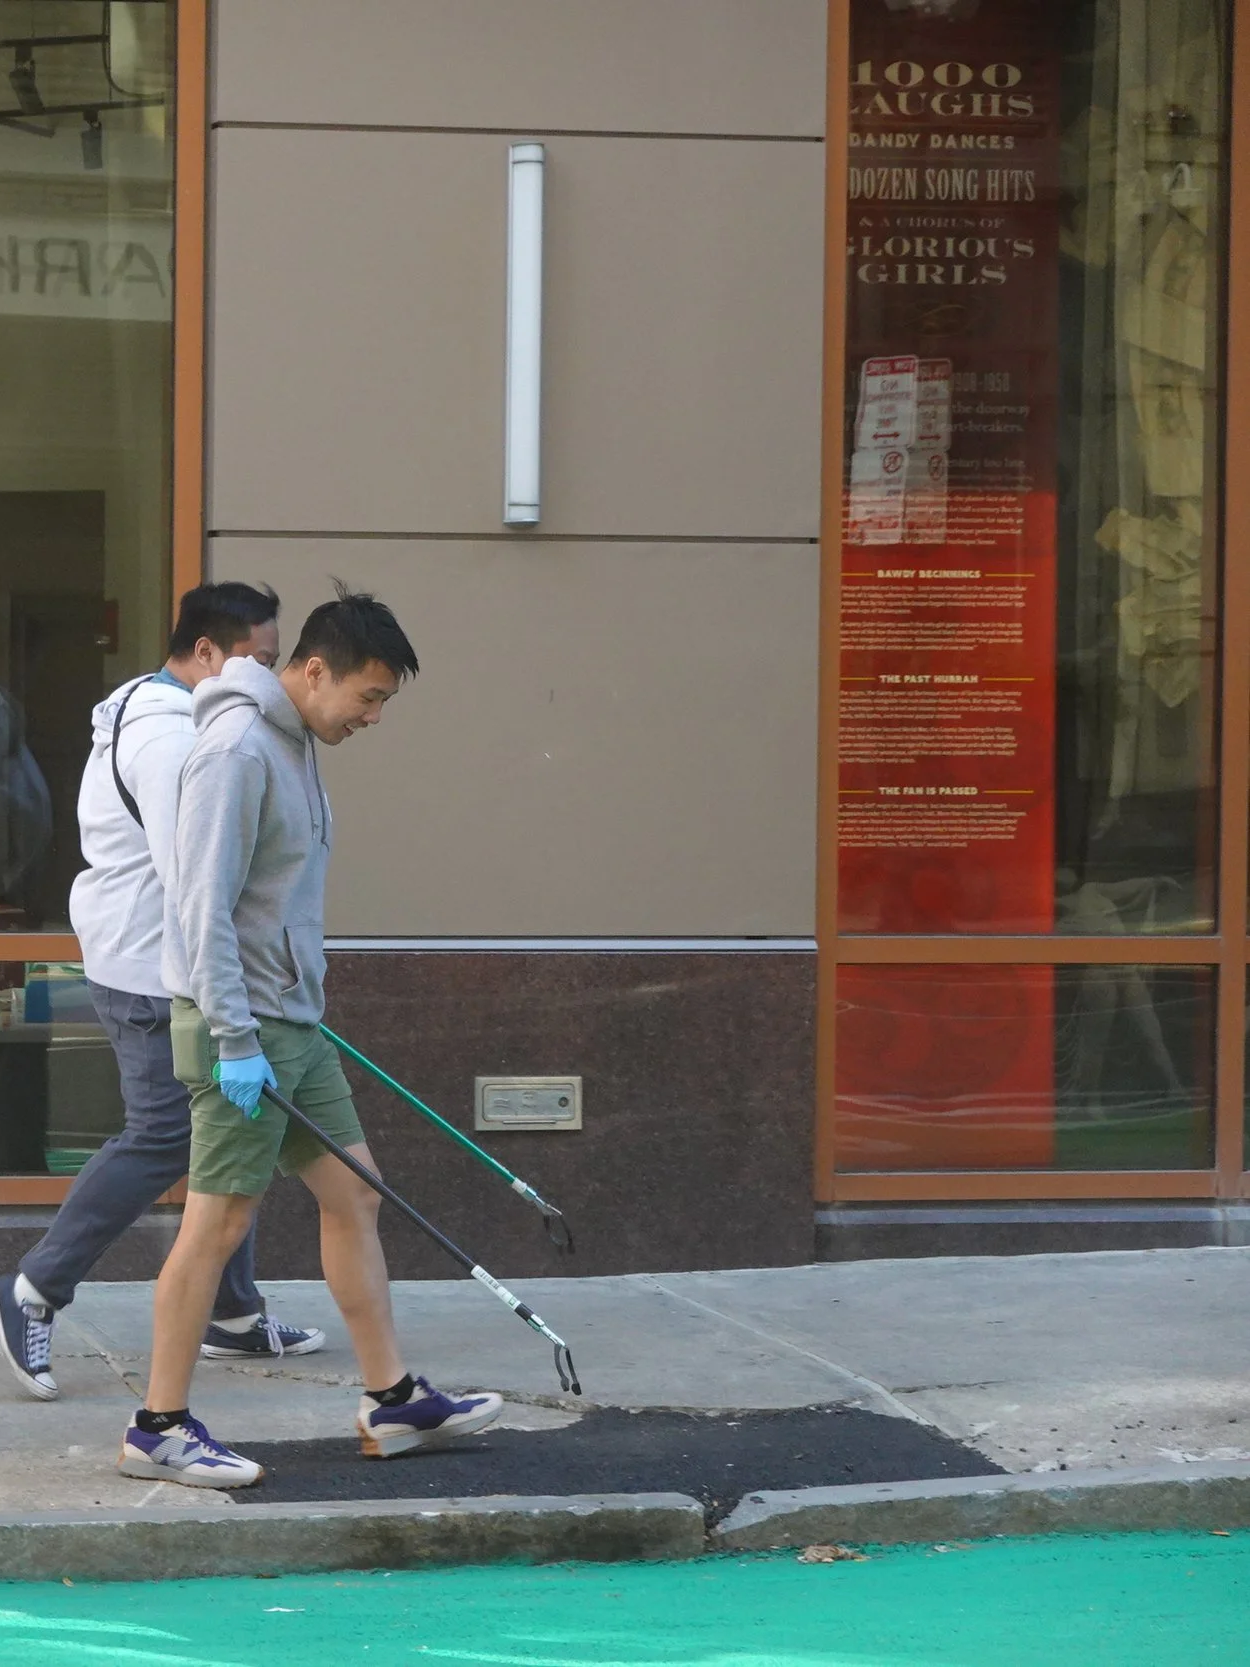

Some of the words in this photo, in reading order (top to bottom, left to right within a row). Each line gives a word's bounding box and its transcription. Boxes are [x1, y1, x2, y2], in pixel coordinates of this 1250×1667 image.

[851, 60, 1022, 88] 1000
[849, 132, 921, 149] DANDY
[929, 134, 1016, 149] DANCES
[850, 167, 918, 200] DOZEN
[924, 168, 979, 200] SONG
[985, 169, 1036, 202] HITS
[979, 217, 1007, 229] OF
[856, 263, 1008, 286] GIRLS
[879, 675, 901, 684] THE
[903, 675, 932, 684] PAST
[879, 787, 900, 796] THE
[902, 787, 924, 796] FAN
[926, 787, 937, 796] IS
[938, 787, 979, 796] PASSED
